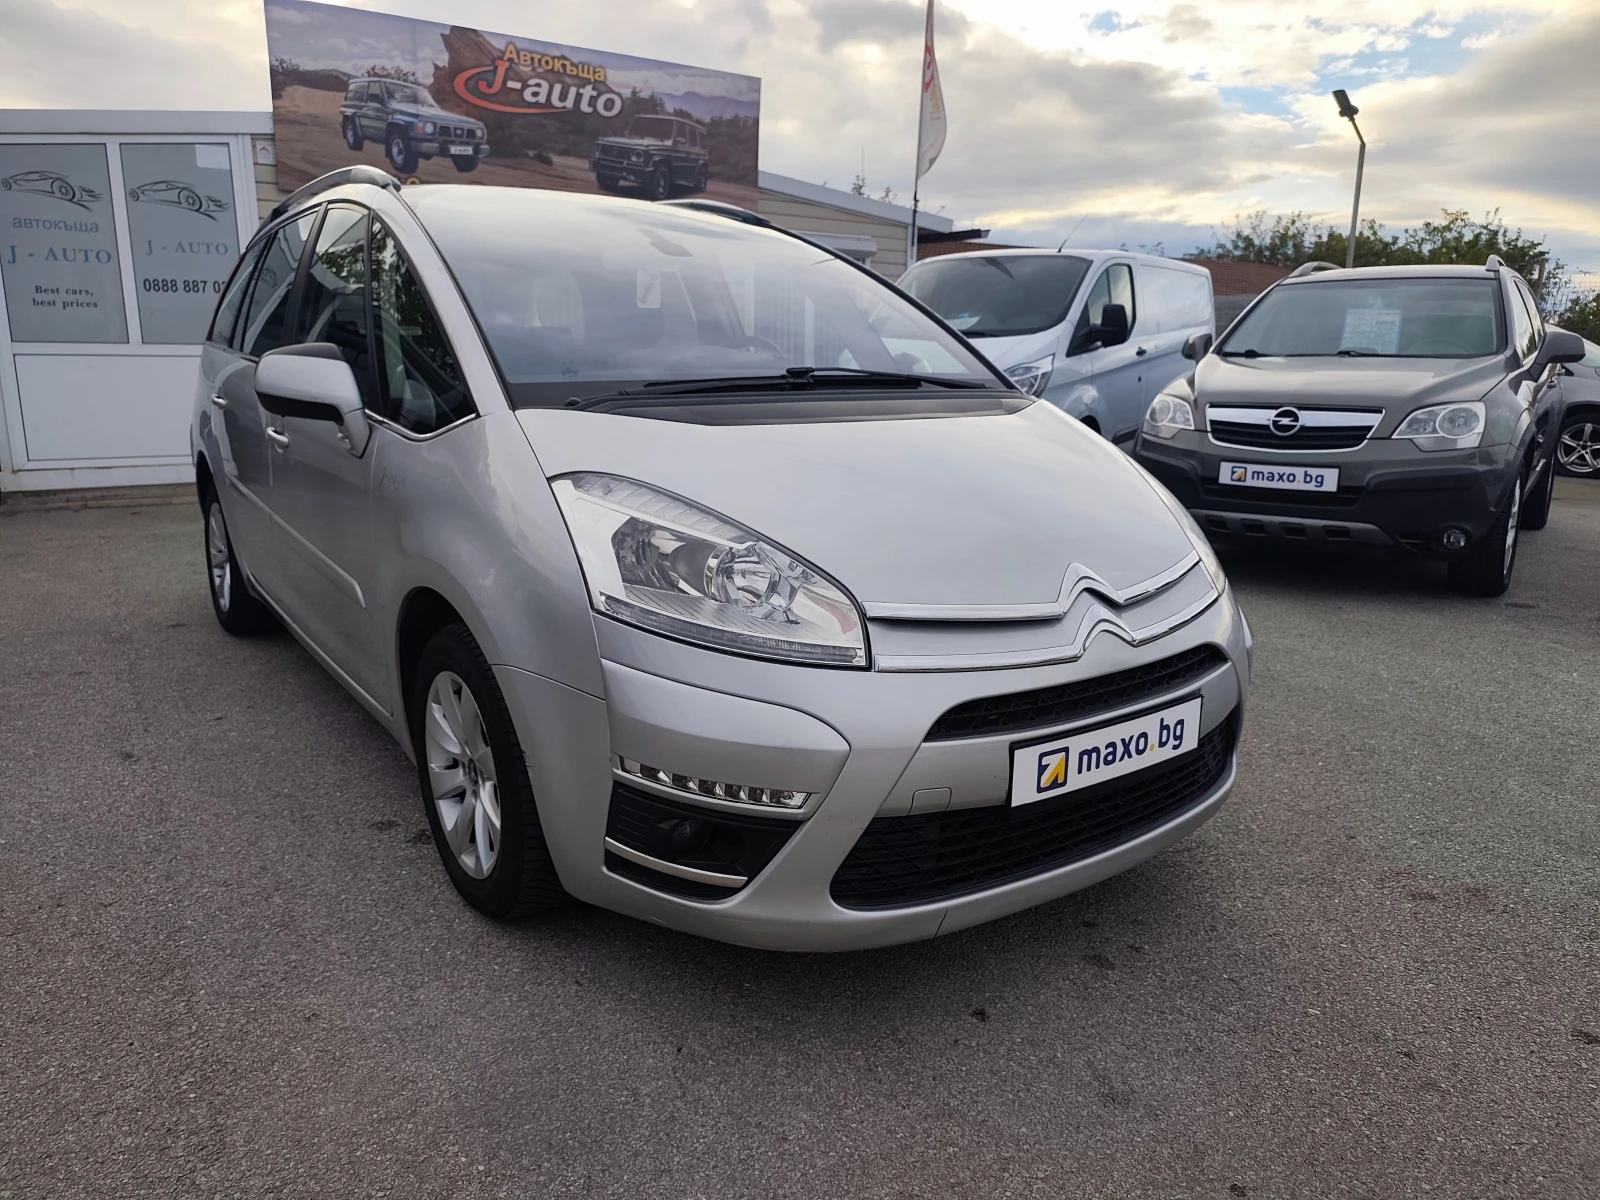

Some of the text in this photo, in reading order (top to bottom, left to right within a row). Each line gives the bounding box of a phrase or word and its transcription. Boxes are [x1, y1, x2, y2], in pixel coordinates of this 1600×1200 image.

[503, 42, 606, 82] Автокъща
[477, 59, 624, 118] J-auto
[12, 217, 99, 234] автокъща
[7, 245, 17, 265] J
[44, 246, 112, 265] AUTO
[145, 240, 153, 256] J
[175, 241, 229, 256] AUTO
[34, 284, 94, 297] Best cars,
[143, 278, 179, 293] 0888
[183, 279, 208, 294] 887
[32, 297, 99, 310] best prices
[1251, 469, 1325, 488] maxo.bg
[1077, 717, 1185, 775] maxo.bg
